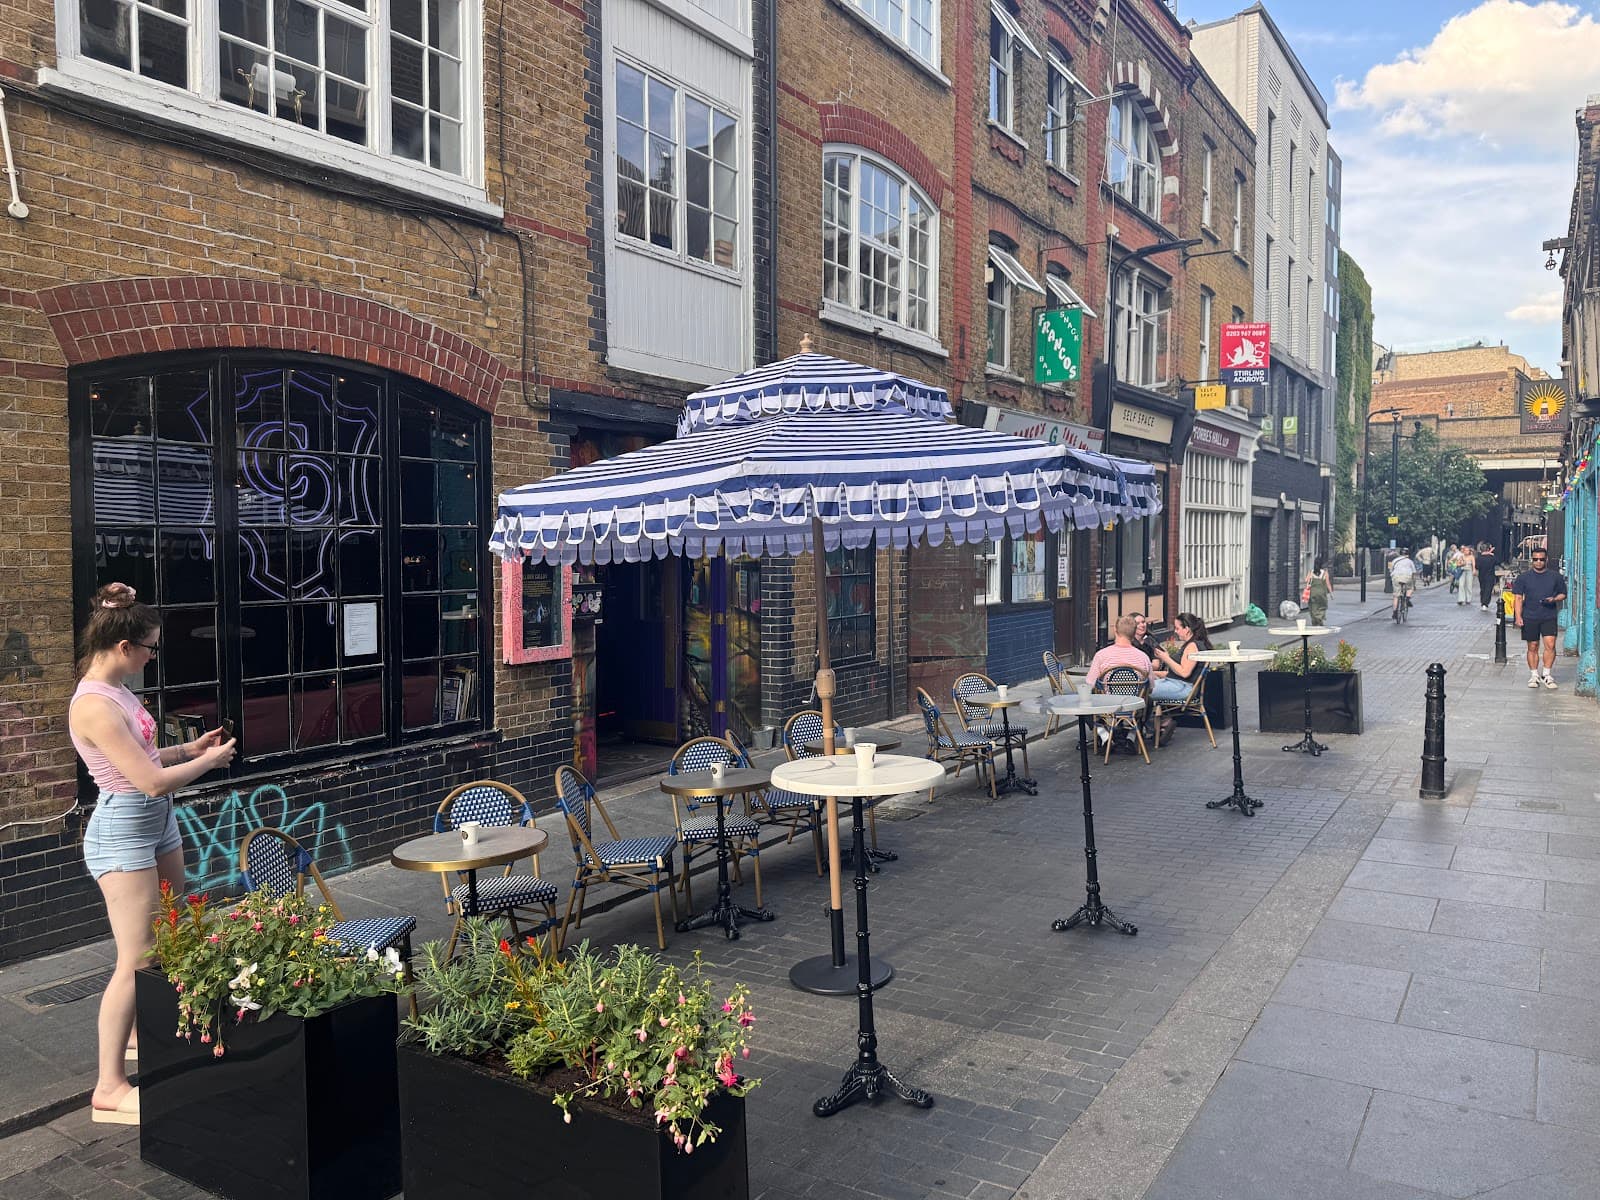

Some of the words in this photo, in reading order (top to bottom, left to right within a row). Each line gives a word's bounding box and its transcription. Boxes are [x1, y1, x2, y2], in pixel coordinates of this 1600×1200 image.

[1060, 311, 1079, 341] SNACK
[1038, 313, 1076, 379] FRANCOS
[1039, 355, 1052, 376] BAR
[1123, 409, 1136, 422] SELF
[1137, 412, 1155, 427] SPACE
[1212, 431, 1223, 447] HALL
